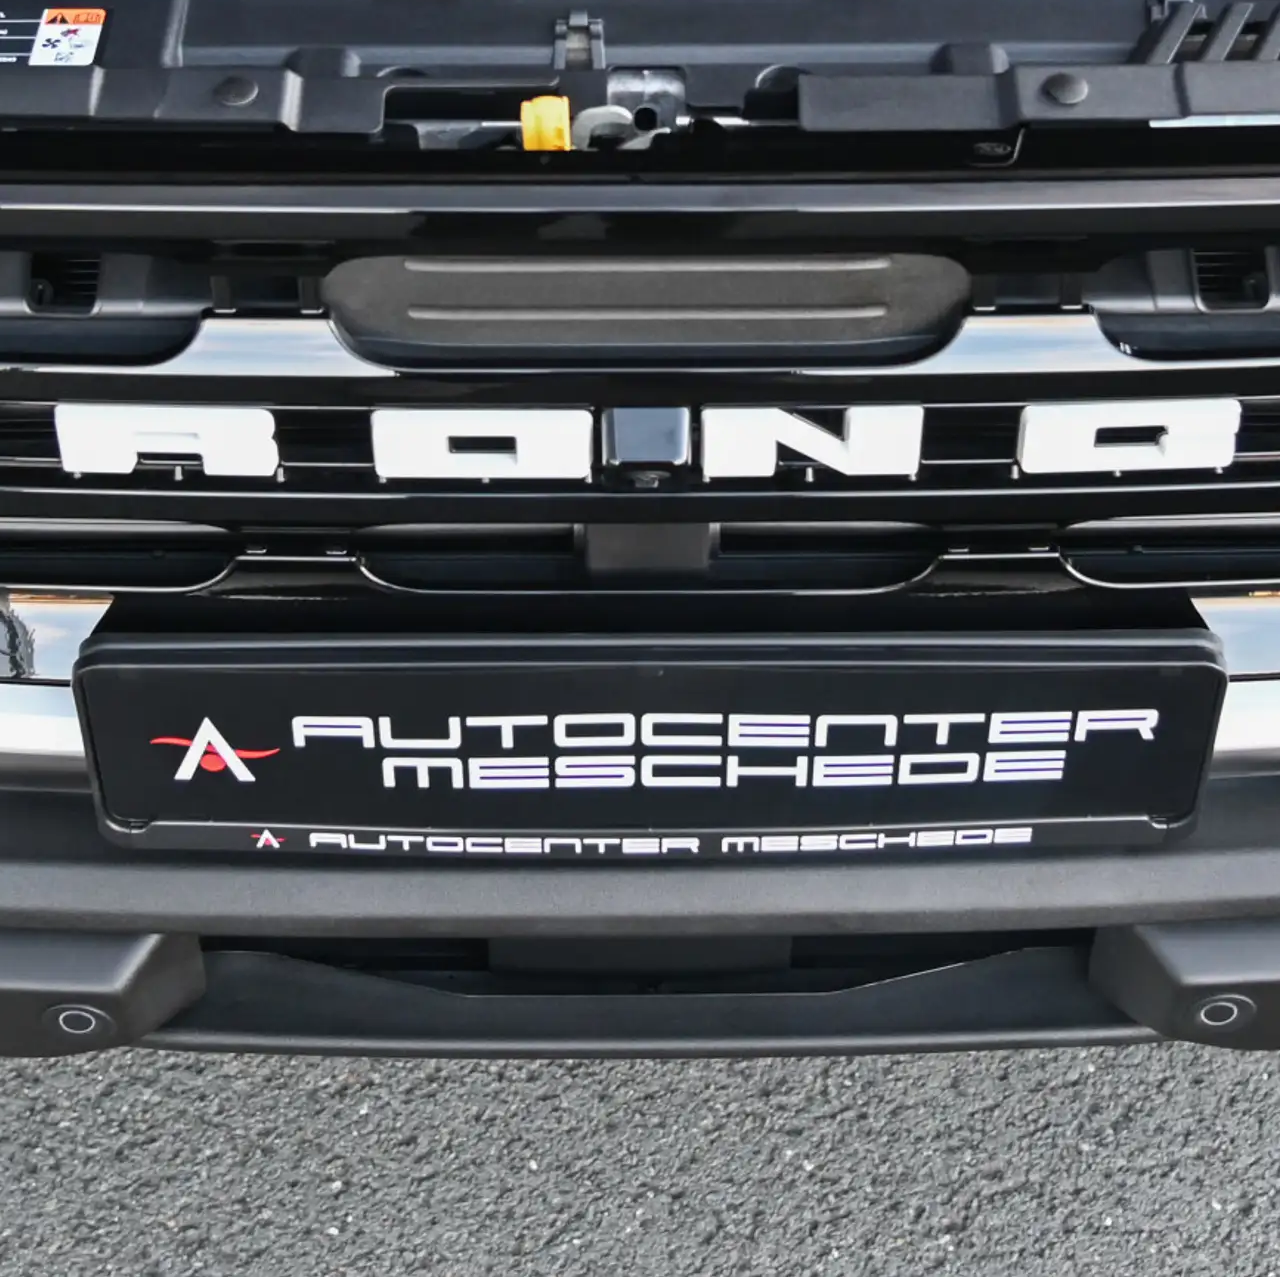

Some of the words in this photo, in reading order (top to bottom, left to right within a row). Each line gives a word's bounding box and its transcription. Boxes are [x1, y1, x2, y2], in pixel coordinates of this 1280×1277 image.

[291, 708, 1160, 749] AUTOCENTER
[381, 749, 1067, 790] MESCHEDE
[309, 832, 700, 854] AUTOCENTER
[721, 827, 1033, 853] MESCHEDE
